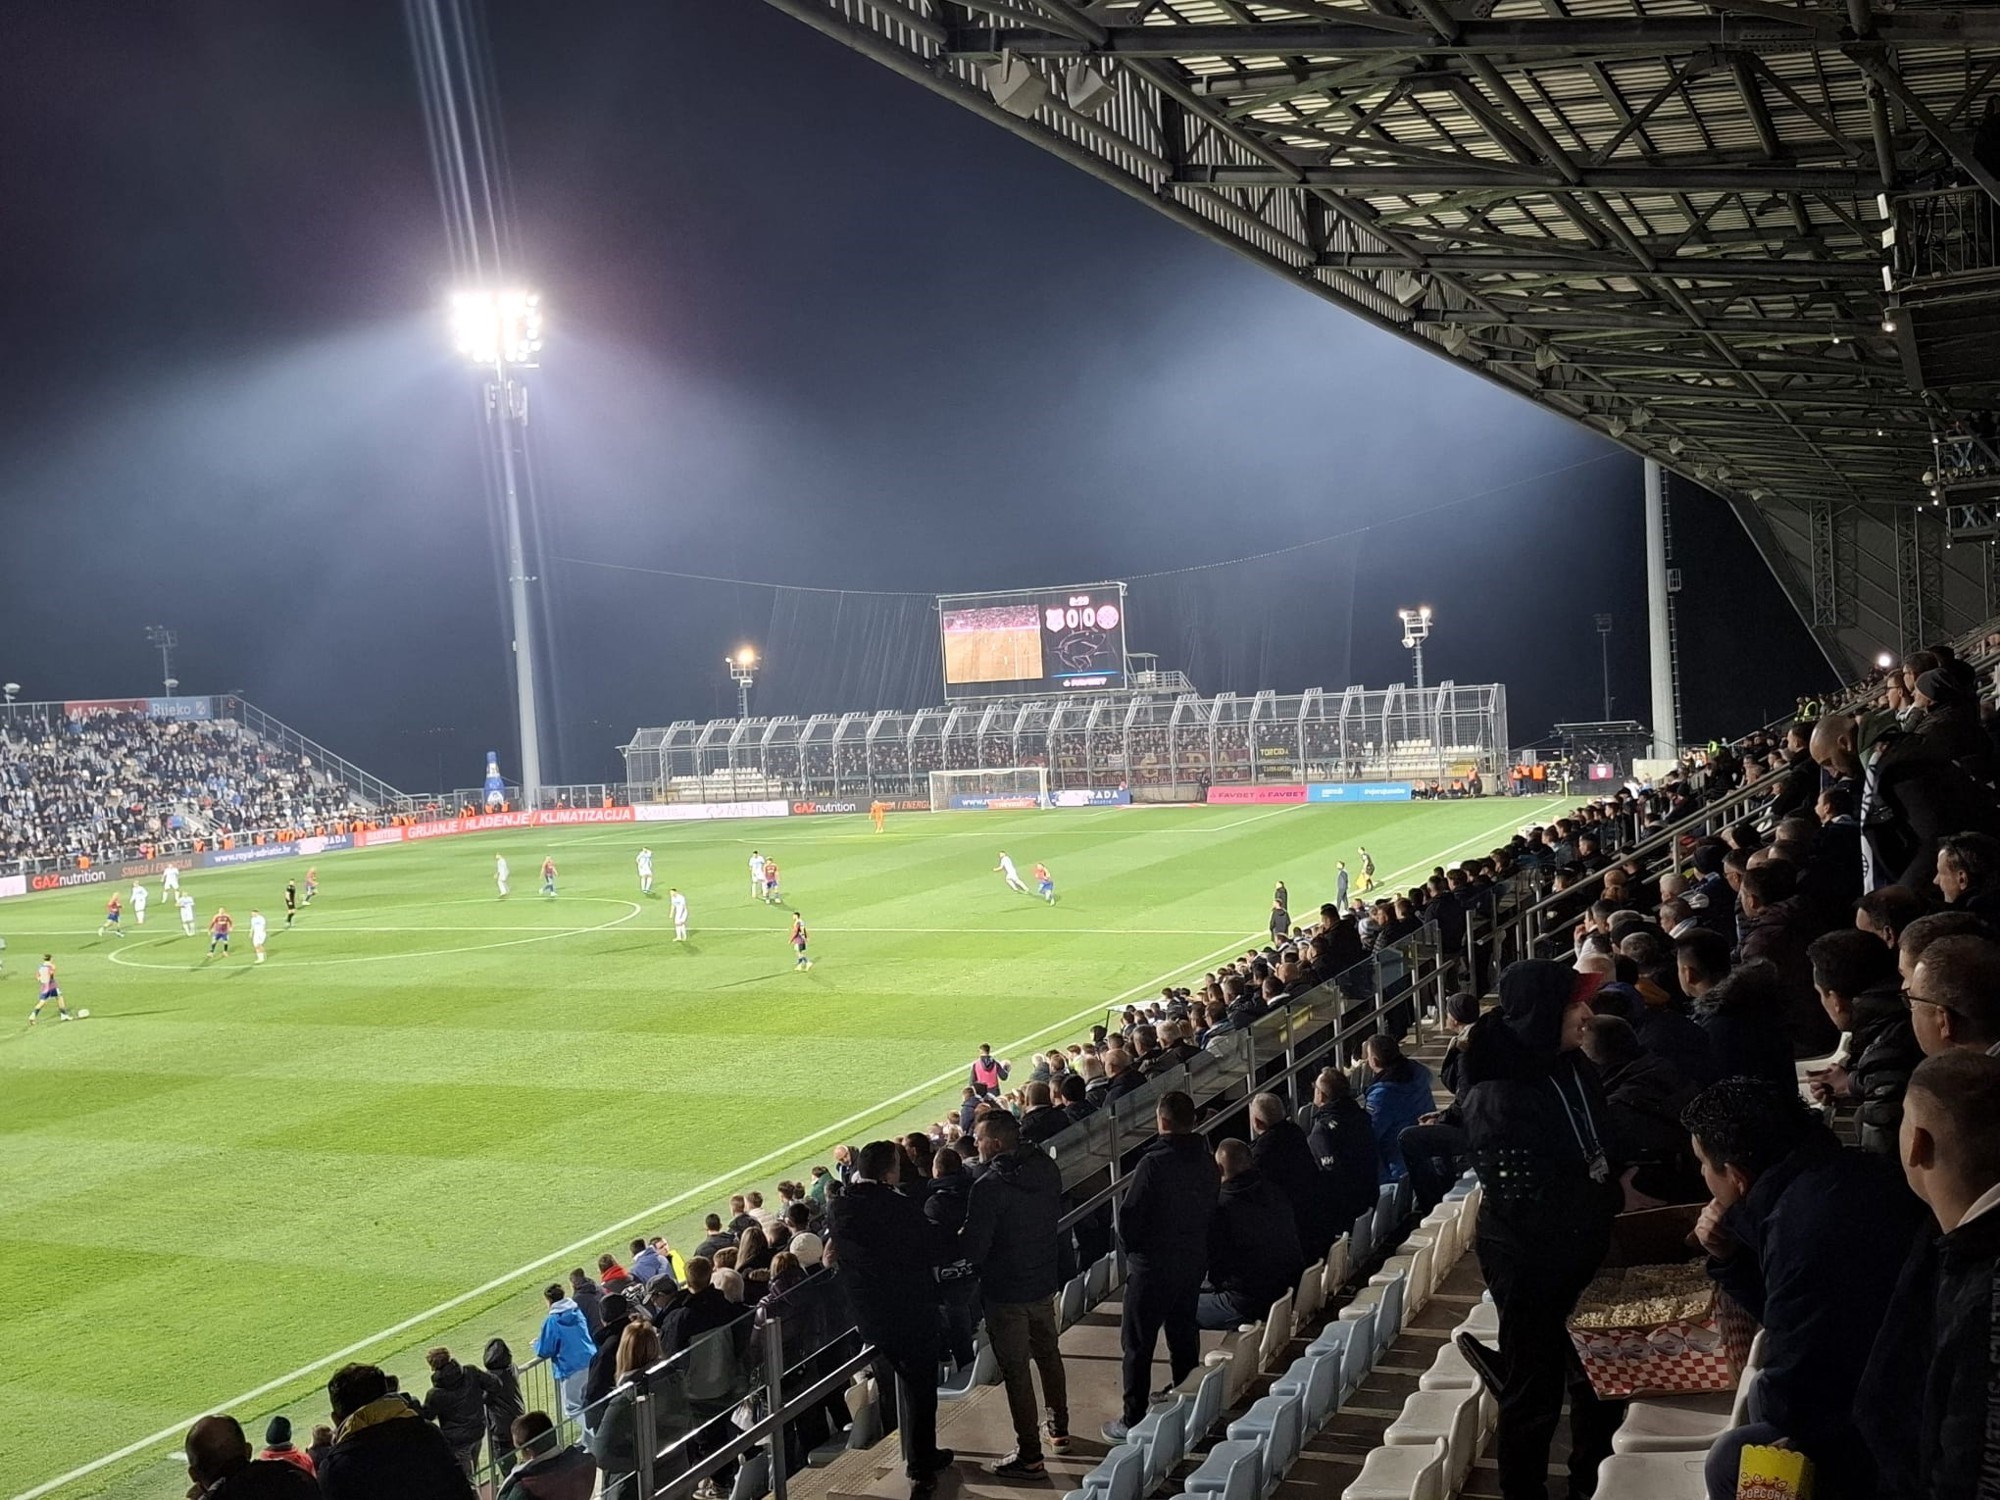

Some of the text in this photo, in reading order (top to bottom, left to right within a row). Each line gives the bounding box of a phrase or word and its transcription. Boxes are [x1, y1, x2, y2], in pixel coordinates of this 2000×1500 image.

[1066, 607, 1095, 628] 0 0
[1218, 791, 1255, 799] FAVBET
[1267, 791, 1305, 799] FAVBET
[793, 801, 856, 814] GAZnutrition
[407, 820, 458, 838] GRIJANJE
[540, 809, 631, 823] KLIMATIZACIJA
[32, 869, 106, 890] GAZnutrition
